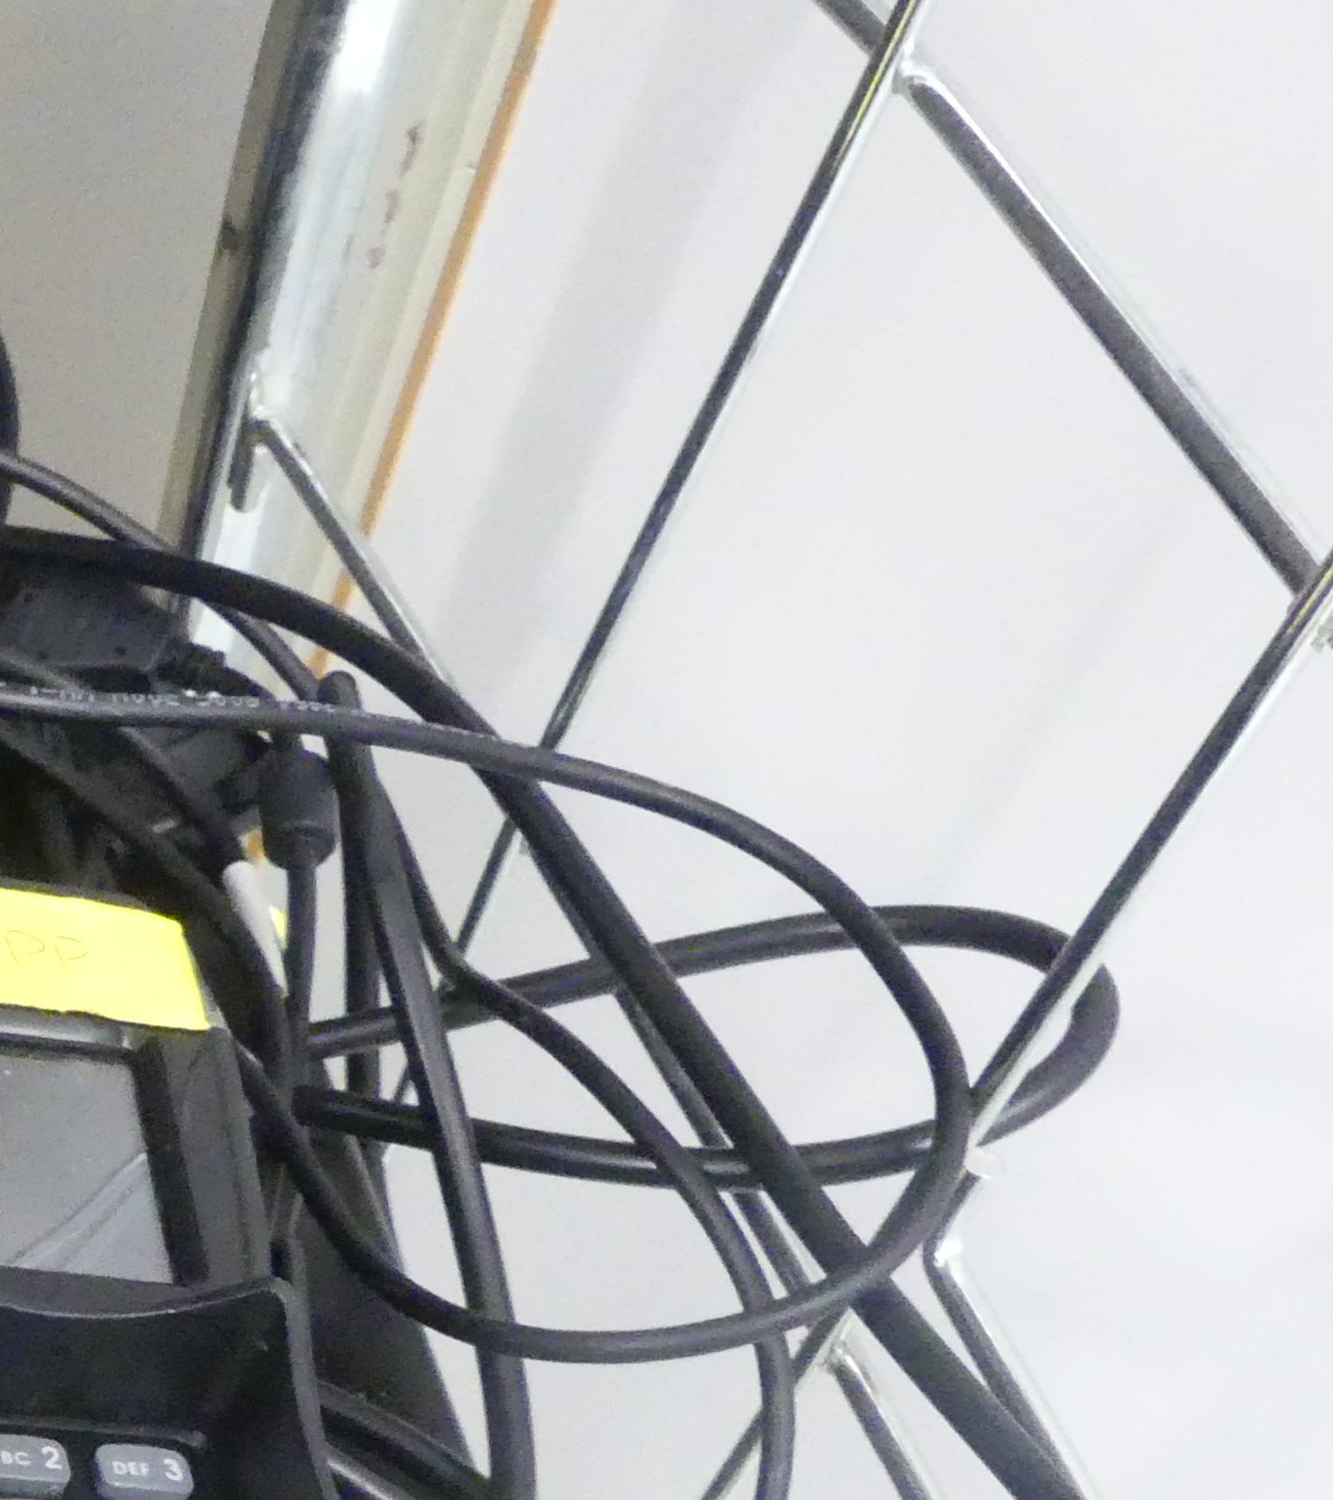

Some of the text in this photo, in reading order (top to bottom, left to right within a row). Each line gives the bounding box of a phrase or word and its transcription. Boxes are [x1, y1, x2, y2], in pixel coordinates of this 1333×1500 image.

[41, 1446, 63, 1470] 2
[112, 1458, 184, 1482] DEF 3
